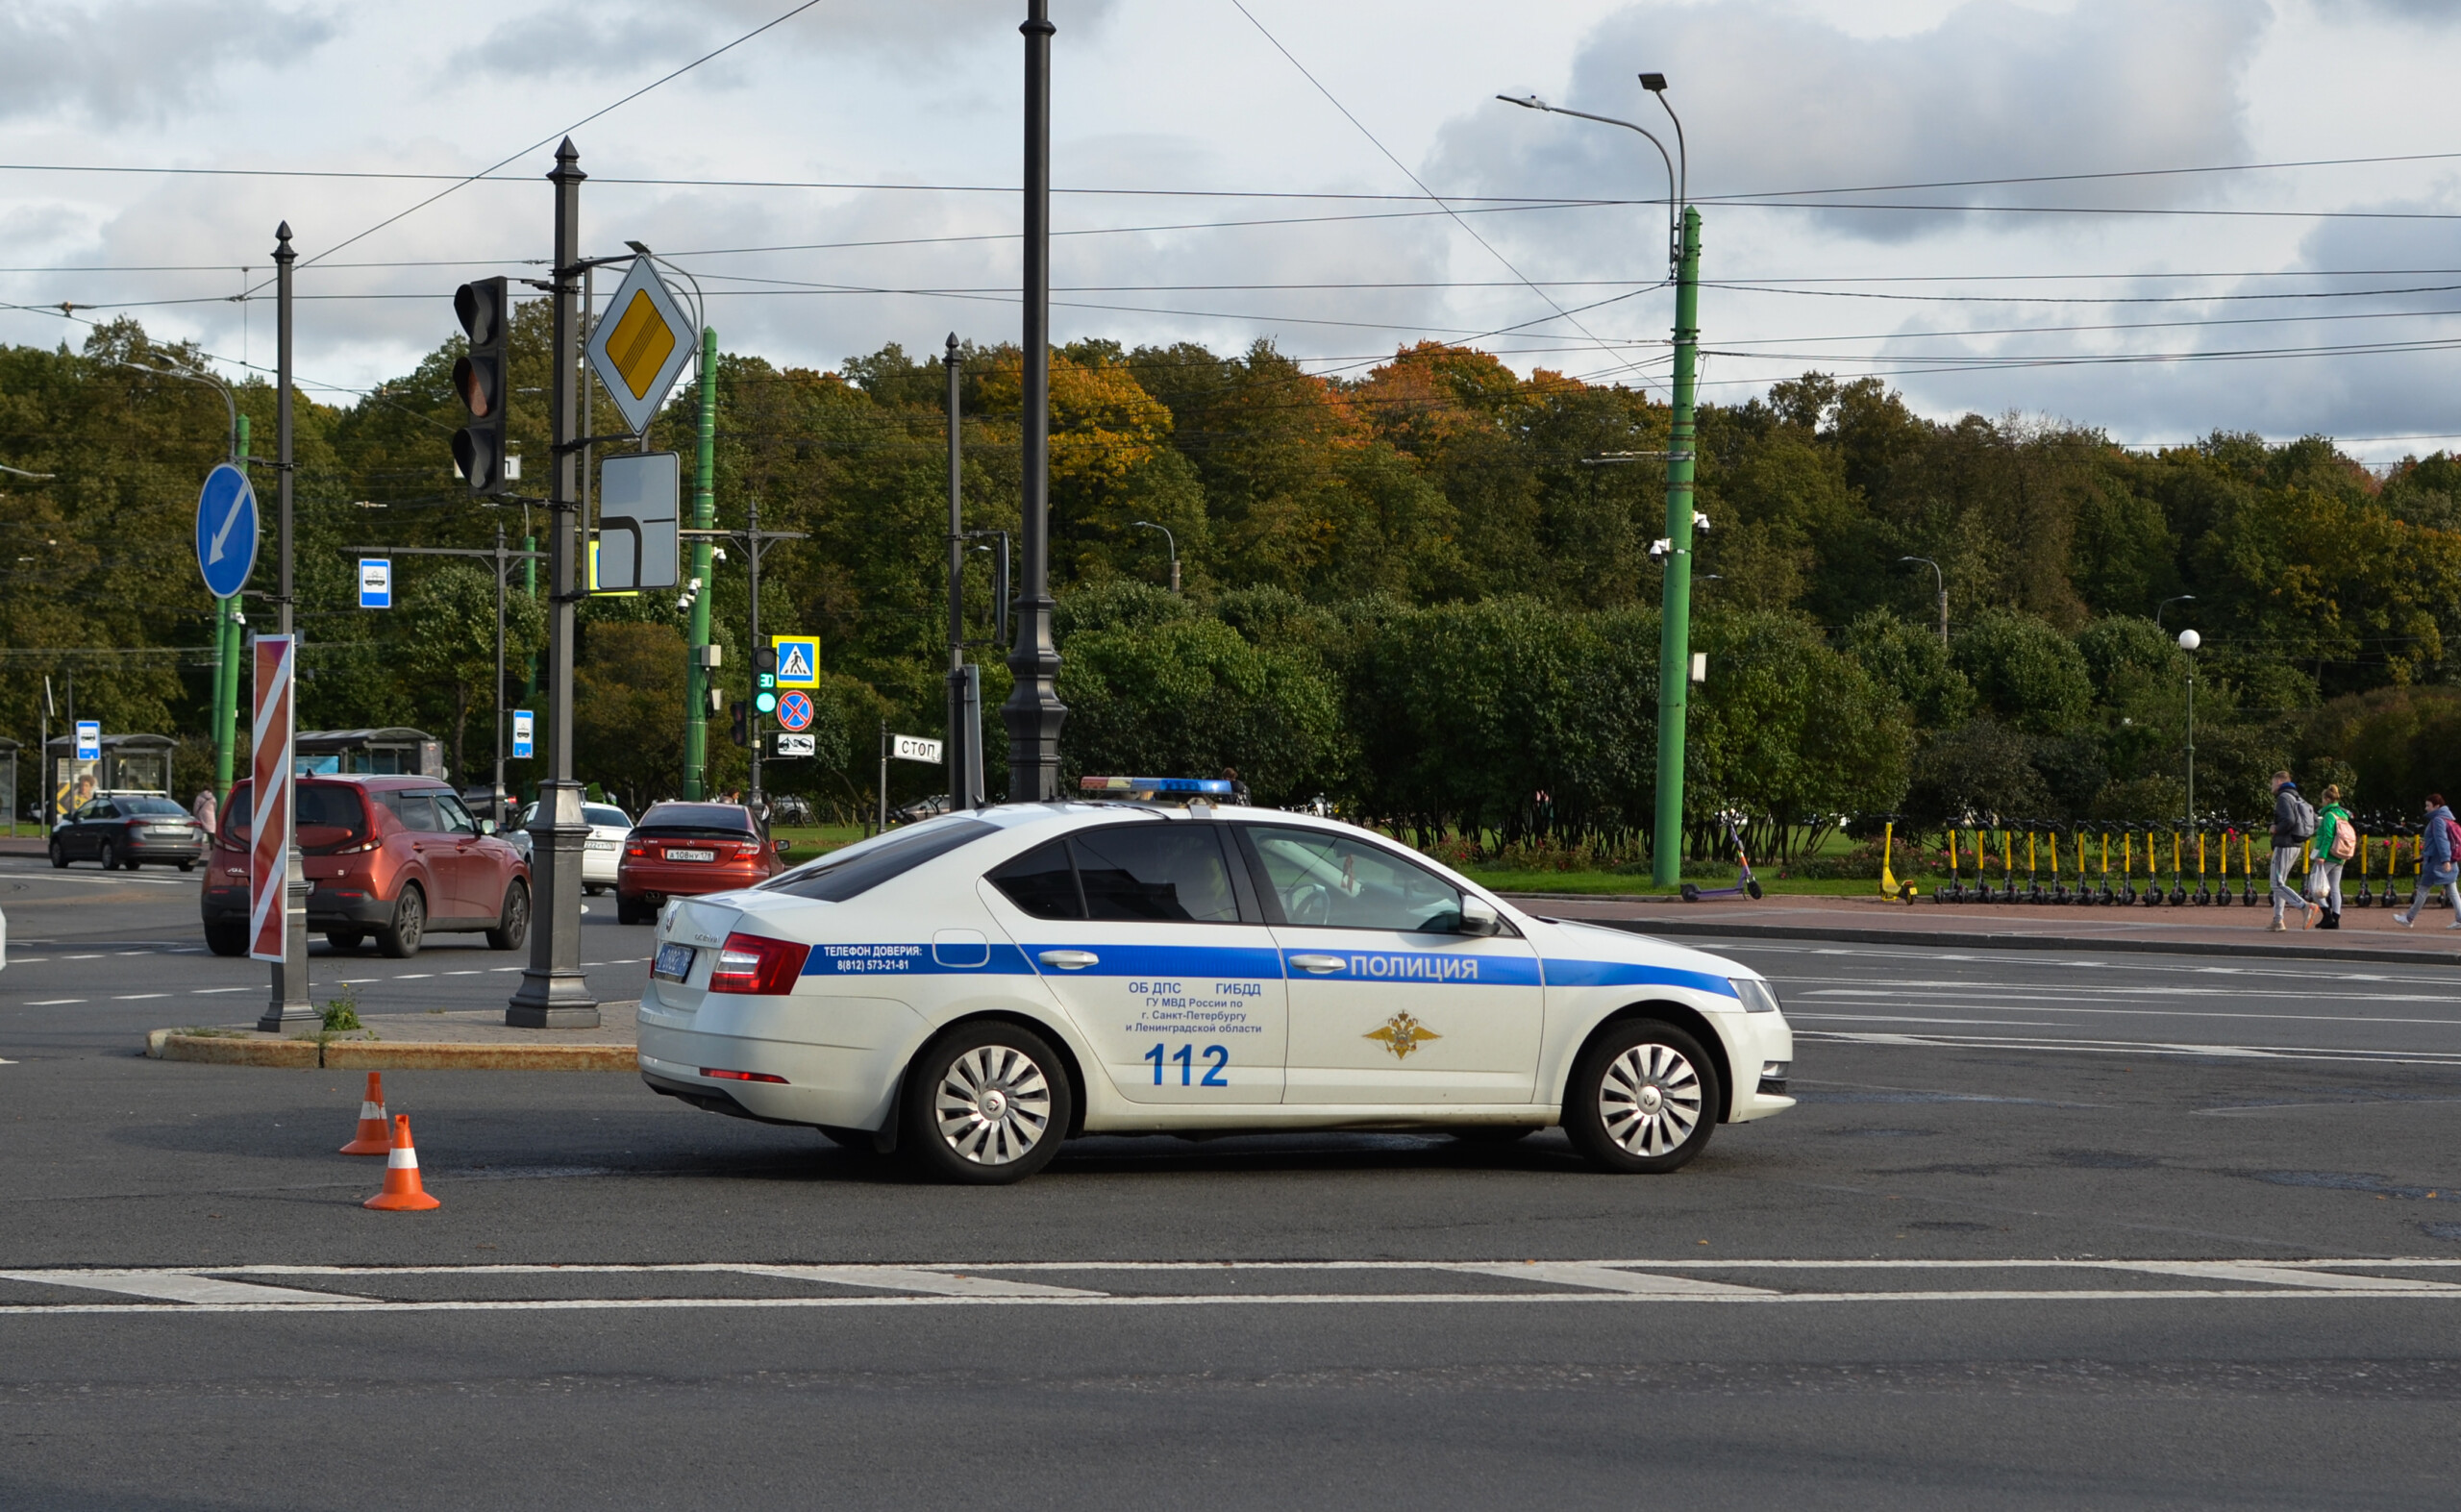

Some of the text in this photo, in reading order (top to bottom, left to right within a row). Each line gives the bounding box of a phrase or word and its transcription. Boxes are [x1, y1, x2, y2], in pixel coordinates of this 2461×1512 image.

[760, 673, 774, 687] 30
[902, 740, 935, 757] СТОП
[824, 946, 923, 957] ТЕЛЕФОН ДОВЕРИЯ:
[837, 960, 908, 972] 8(812) 573-21-81
[1351, 954, 1479, 980] ПОЛИЦИЯ
[1129, 982, 1261, 997] ОБ ДПС ГИБДД
[1146, 998, 1158, 1007] ГУ
[1161, 998, 1186, 1008] МВД
[1189, 999, 1228, 1008] России
[1152, 1010, 1247, 1023] Санкт-Петербургу
[1135, 1023, 1216, 1034] Ленинградской
[1218, 1024, 1262, 1033] области
[1144, 1043, 1230, 1087] 112
